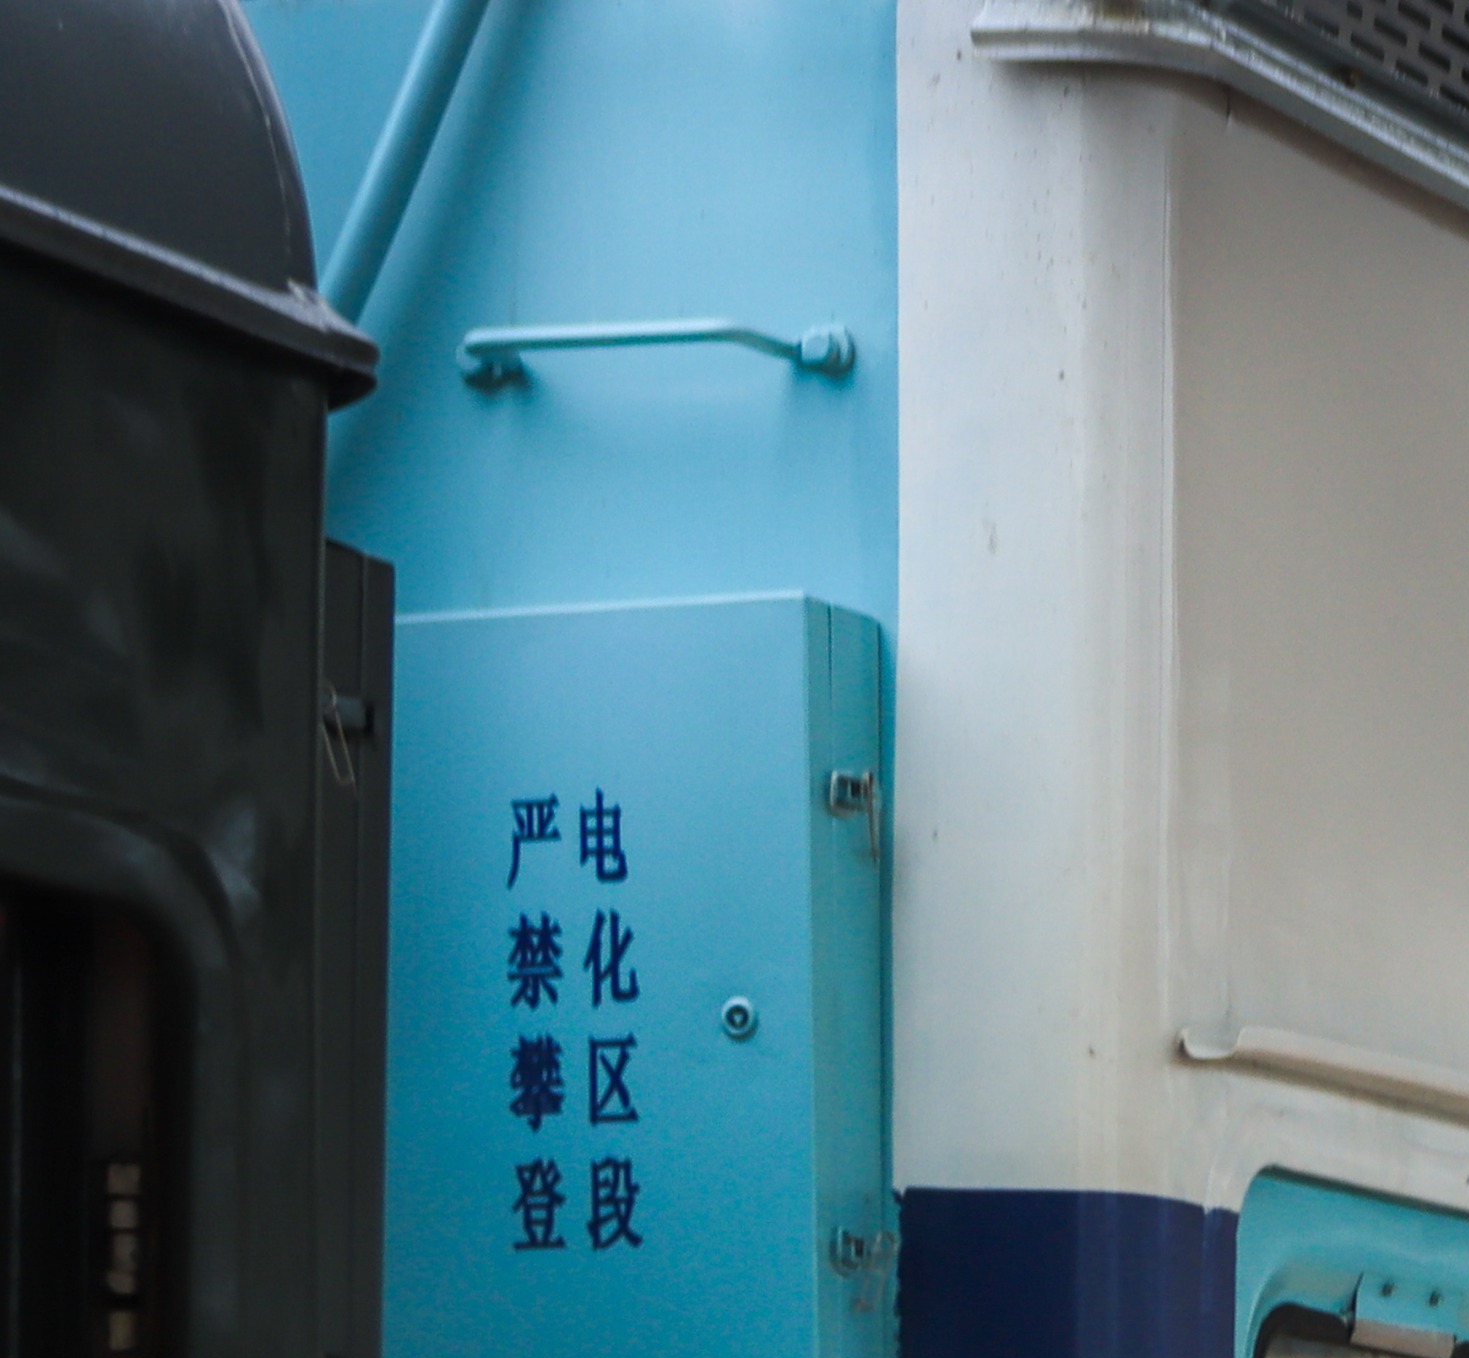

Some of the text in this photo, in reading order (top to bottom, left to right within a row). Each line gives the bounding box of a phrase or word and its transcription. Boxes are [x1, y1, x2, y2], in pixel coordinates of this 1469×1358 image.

[506, 795, 566, 1252] 严禁攀登
[578, 787, 643, 1251] 电化区段
